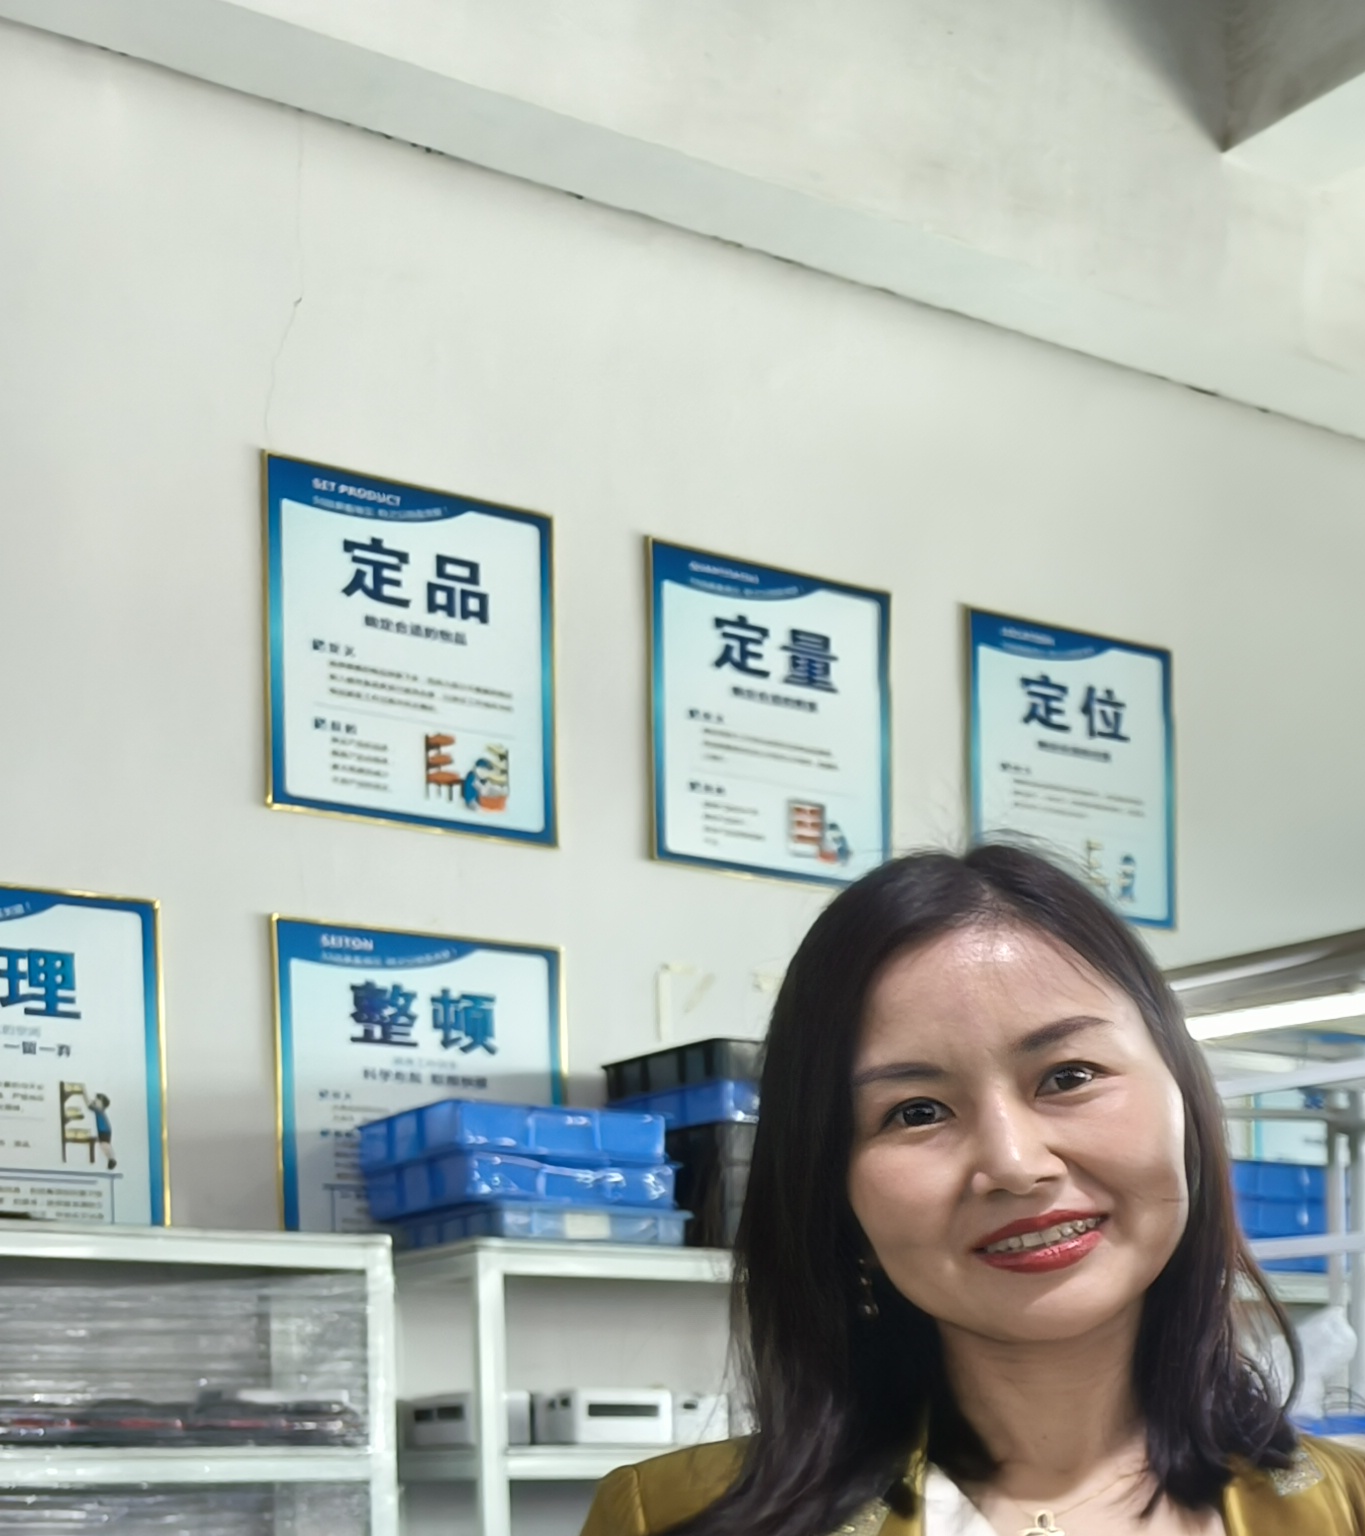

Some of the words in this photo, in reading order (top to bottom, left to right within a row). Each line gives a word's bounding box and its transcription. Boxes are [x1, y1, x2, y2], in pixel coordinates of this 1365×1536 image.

[312, 478, 336, 491] SET
[338, 483, 401, 506] PRODUCT
[341, 536, 489, 625] 定品
[713, 615, 839, 694] 定量
[1020, 674, 1131, 743] 定位
[320, 933, 374, 951] SEITON
[349, 980, 499, 1056] 整顿
